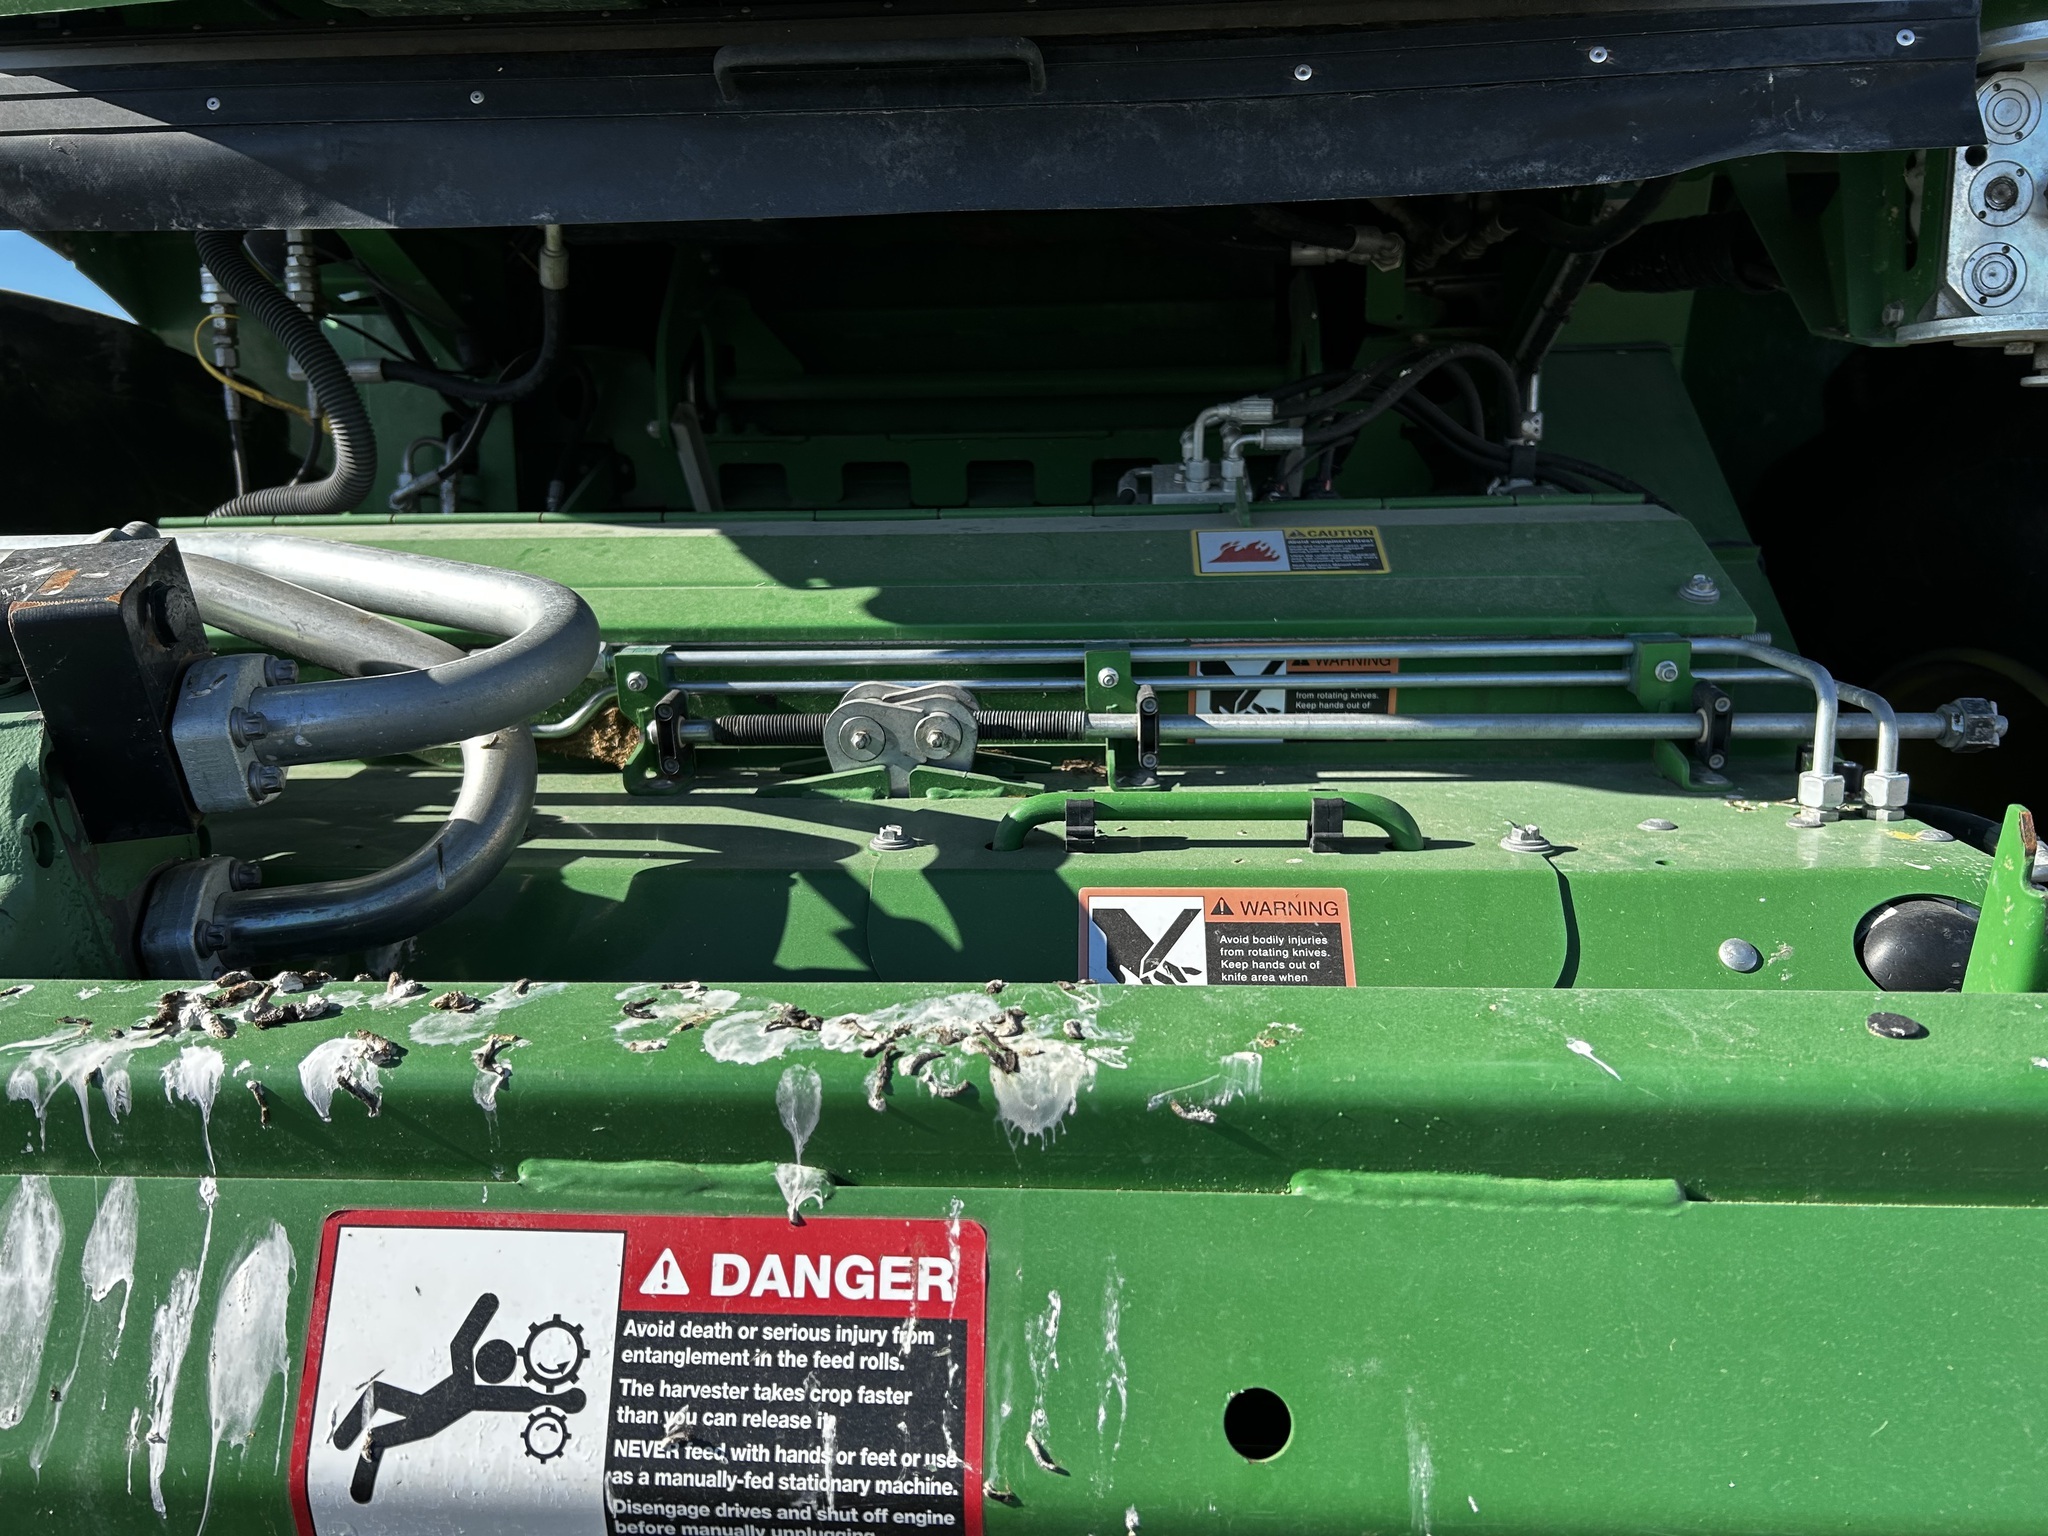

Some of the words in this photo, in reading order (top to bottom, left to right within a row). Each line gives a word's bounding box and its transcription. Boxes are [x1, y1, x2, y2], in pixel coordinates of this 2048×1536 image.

[1307, 529, 1374, 537] CAUTION
[1314, 658, 1391, 666] WARNING
[1296, 691, 1314, 699] from
[1317, 692, 1348, 701] rotating
[1350, 691, 1379, 699] knives.
[1295, 701, 1316, 710] Keep
[1319, 701, 1344, 709] hands
[1362, 701, 1371, 709] of
[1240, 901, 1339, 916] WARNING
[1220, 935, 1249, 945] Avoid
[1253, 935, 1284, 947] bodily
[1288, 935, 1328, 947] injuries
[1220, 947, 1246, 957] from
[1248, 948, 1289, 959] rotating
[1292, 947, 1331, 957] knives.
[1221, 960, 1249, 971] Keep
[1252, 959, 1285, 970] hands
[1288, 961, 1306, 970] out
[1309, 959, 1320, 970] of
[1221, 972, 1248, 982] knife
[1251, 974, 1275, 982] area
[1279, 972, 1308, 982] when
[710, 1253, 955, 1302] DANGER
[623, 1319, 676, 1338] Avoid
[680, 1321, 732, 1340] death
[738, 1326, 756, 1340] or
[763, 1324, 831, 1342] serious
[836, 1325, 887, 1347] injury
[892, 1327, 935, 1345] from
[621, 1347, 750, 1368] entanglement
[755, 1349, 772, 1367] in
[777, 1350, 808, 1369] the
[813, 1351, 854, 1370] feed
[860, 1353, 905, 1371] rolls.
[619, 1378, 654, 1397] The
[659, 1380, 749, 1400] harvester
[753, 1382, 805, 1402] takes
[810, 1388, 852, 1406] crop
[857, 1385, 913, 1405] faster
[616, 1407, 659, 1424] than
[664, 1411, 697, 1430] you
[702, 1412, 737, 1428] can
[742, 1409, 812, 1430] release
[816, 1411, 836, 1430] it
[614, 1440, 679, 1459] NEVER
[684, 1443, 726, 1461] feed
[730, 1445, 770, 1462] with
[775, 1446, 831, 1464] hands
[836, 1451, 856, 1465] or
[860, 1448, 897, 1466] feet
[901, 1453, 921, 1467] or
[925, 1453, 957, 1468] use
[611, 1471, 634, 1485] as
[638, 1473, 650, 1486] a
[654, 1470, 774, 1492] manually-fed
[778, 1473, 870, 1496] stationary
[875, 1476, 959, 1496] machine.
[614, 1499, 710, 1520] Disengage
[715, 1502, 772, 1519] drives
[777, 1504, 813, 1521] and
[817, 1506, 858, 1523] shut
[862, 1507, 888, 1523] off
[892, 1509, 955, 1528] engine
[615, 1520, 676, 1535] before
[681, 1522, 765, 1536] manually
